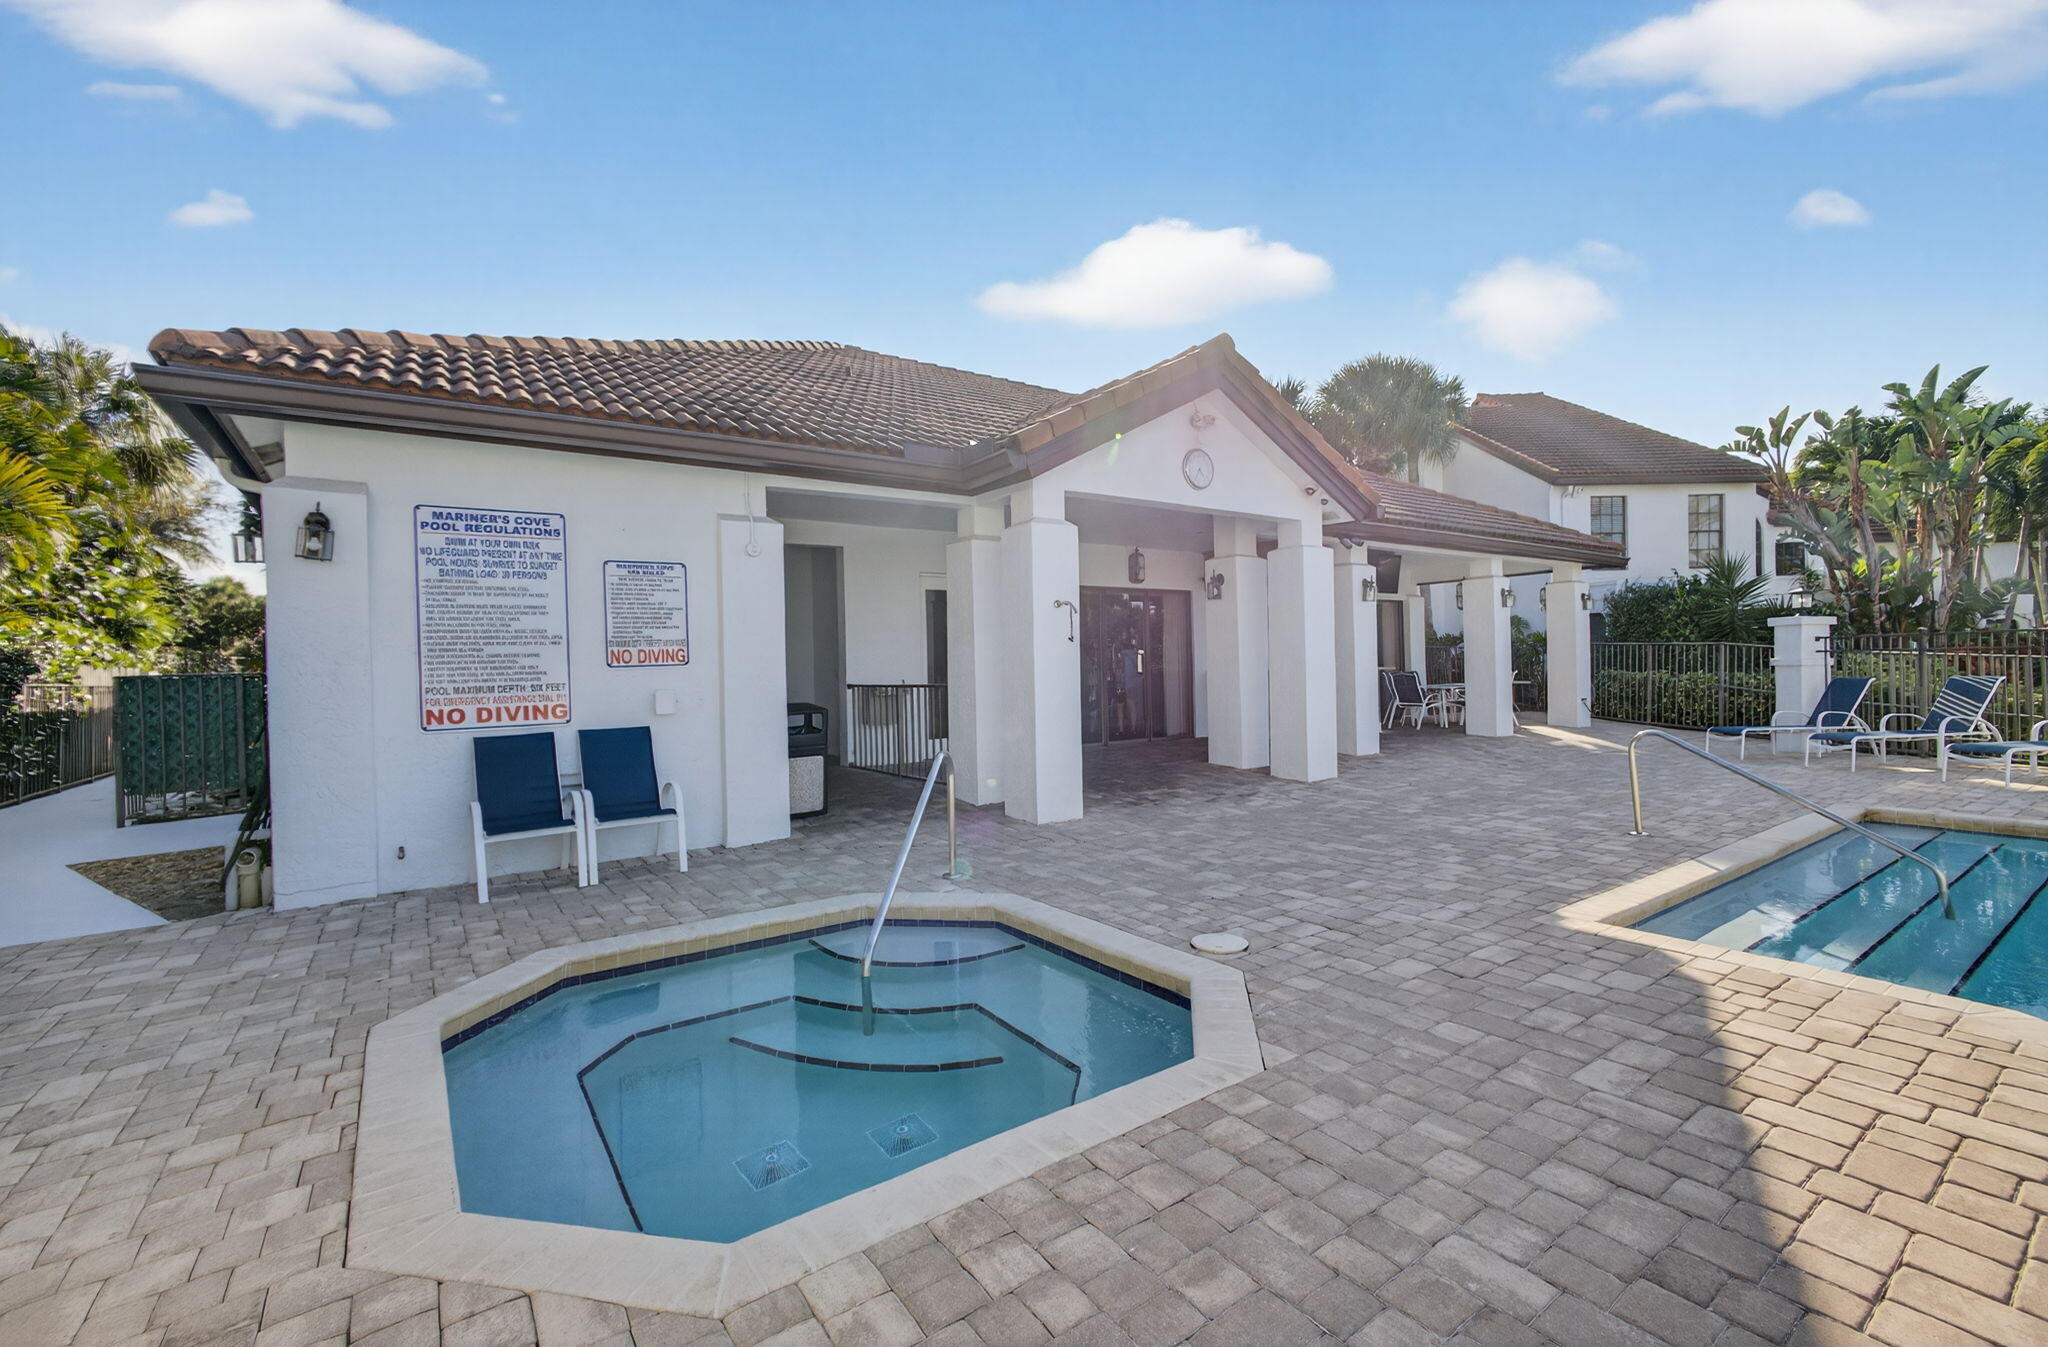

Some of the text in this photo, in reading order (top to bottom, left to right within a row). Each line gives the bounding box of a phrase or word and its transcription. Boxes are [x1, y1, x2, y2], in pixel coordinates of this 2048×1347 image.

[432, 511, 550, 527] MARINER'S COVE
[420, 521, 561, 538] POOL REGULATIONS
[480, 539, 501, 548] YOUR
[426, 557, 448, 567] POOL
[517, 561, 528, 570] TO
[610, 648, 686, 665] NO DIVING
[425, 687, 451, 696] POOL
[425, 704, 568, 726] NO DIVING
